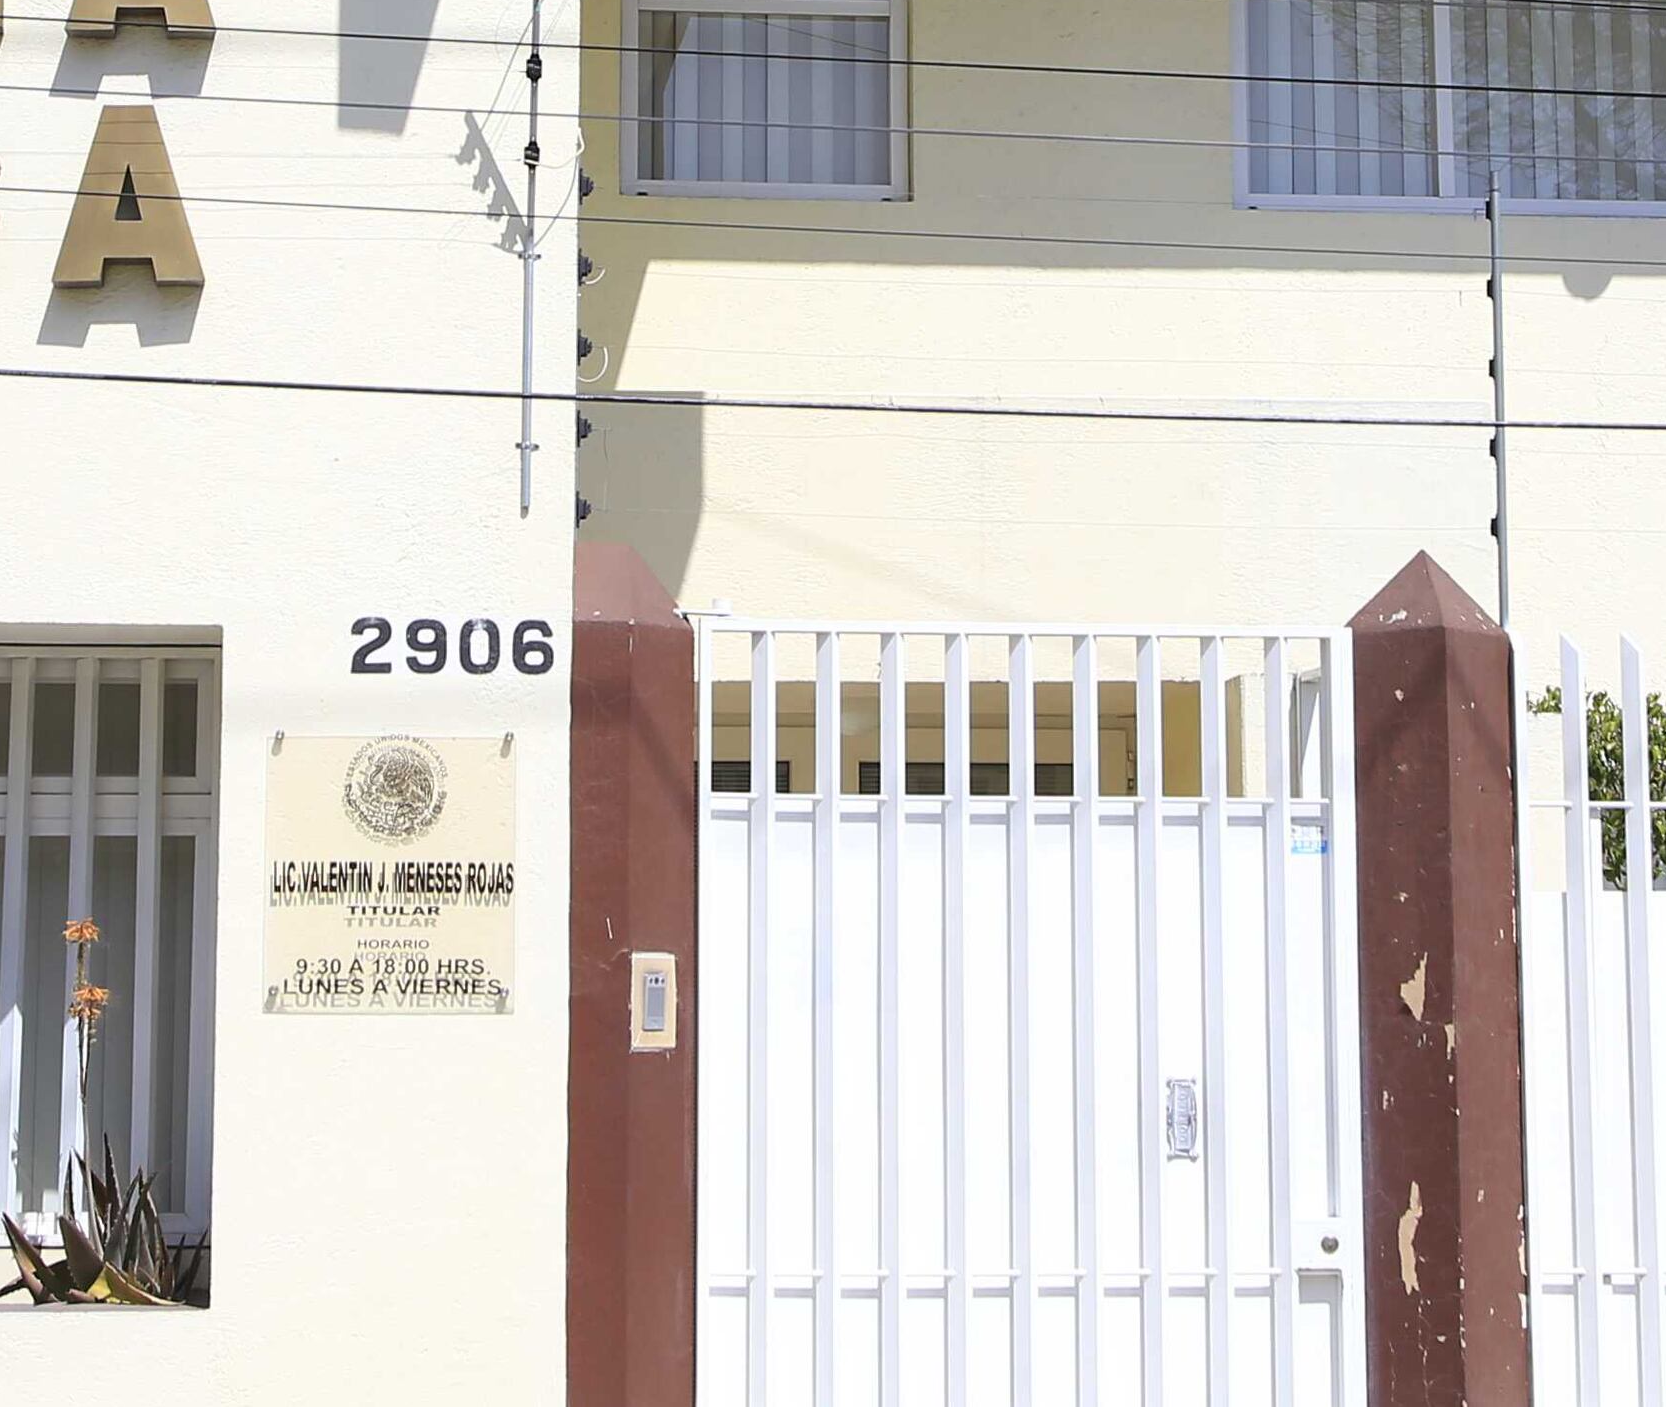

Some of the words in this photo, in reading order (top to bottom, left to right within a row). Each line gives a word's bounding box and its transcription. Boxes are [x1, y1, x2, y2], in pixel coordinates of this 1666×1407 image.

[351, 616, 555, 675] 2906
[377, 862, 389, 893] J.
[395, 862, 462, 893] MENESES
[467, 863, 514, 894] ROJAS
[346, 906, 441, 916] TITULAR
[357, 939, 430, 949] HORARIO
[296, 959, 342, 974] 9:30
[349, 959, 364, 974] A
[373, 959, 430, 974] 18:00
[437, 960, 491, 975] HRS.
[283, 979, 364, 995] LUNES
[372, 979, 388, 994] A
[397, 979, 502, 995] VIERNES
